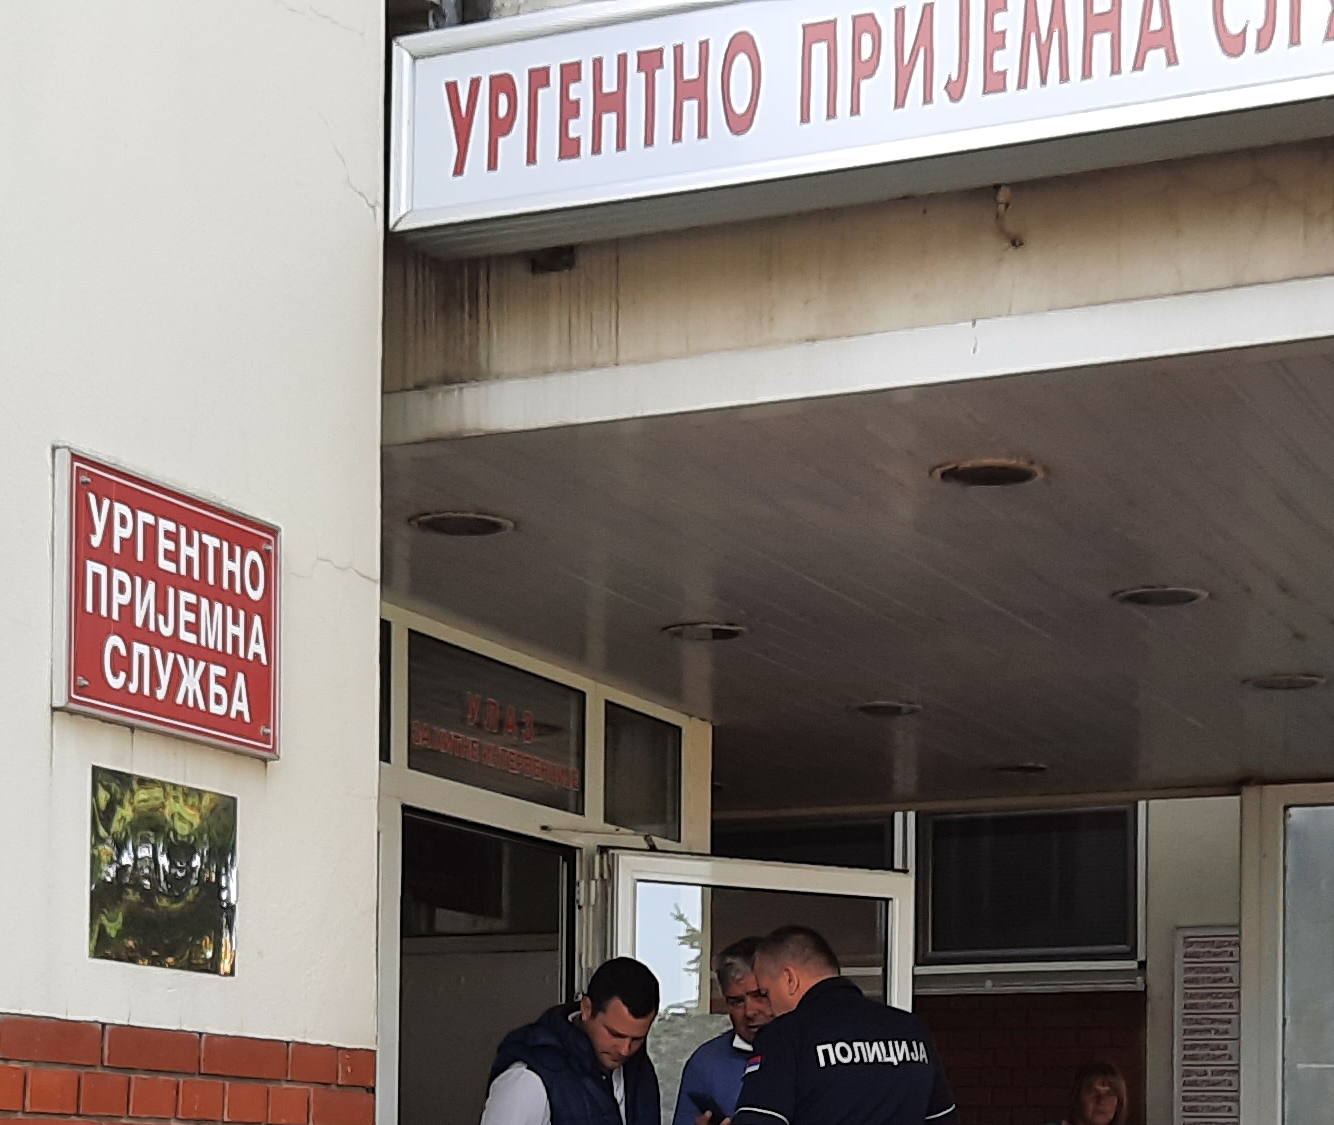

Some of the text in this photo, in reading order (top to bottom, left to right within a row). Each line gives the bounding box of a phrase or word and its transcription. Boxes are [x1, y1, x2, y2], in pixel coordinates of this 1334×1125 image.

[445, 31, 762, 178] УРГЕНТНО
[799, 0, 1180, 125] ПРИЈЕМНА
[87, 491, 266, 601] УРГЕНТНО
[85, 559, 268, 666] ПРИЈЕМНА
[103, 633, 252, 723] СЛУЖБА
[465, 690, 535, 744] УЛАЗ
[816, 1040, 929, 1068] ПОЛИЦИЈА
